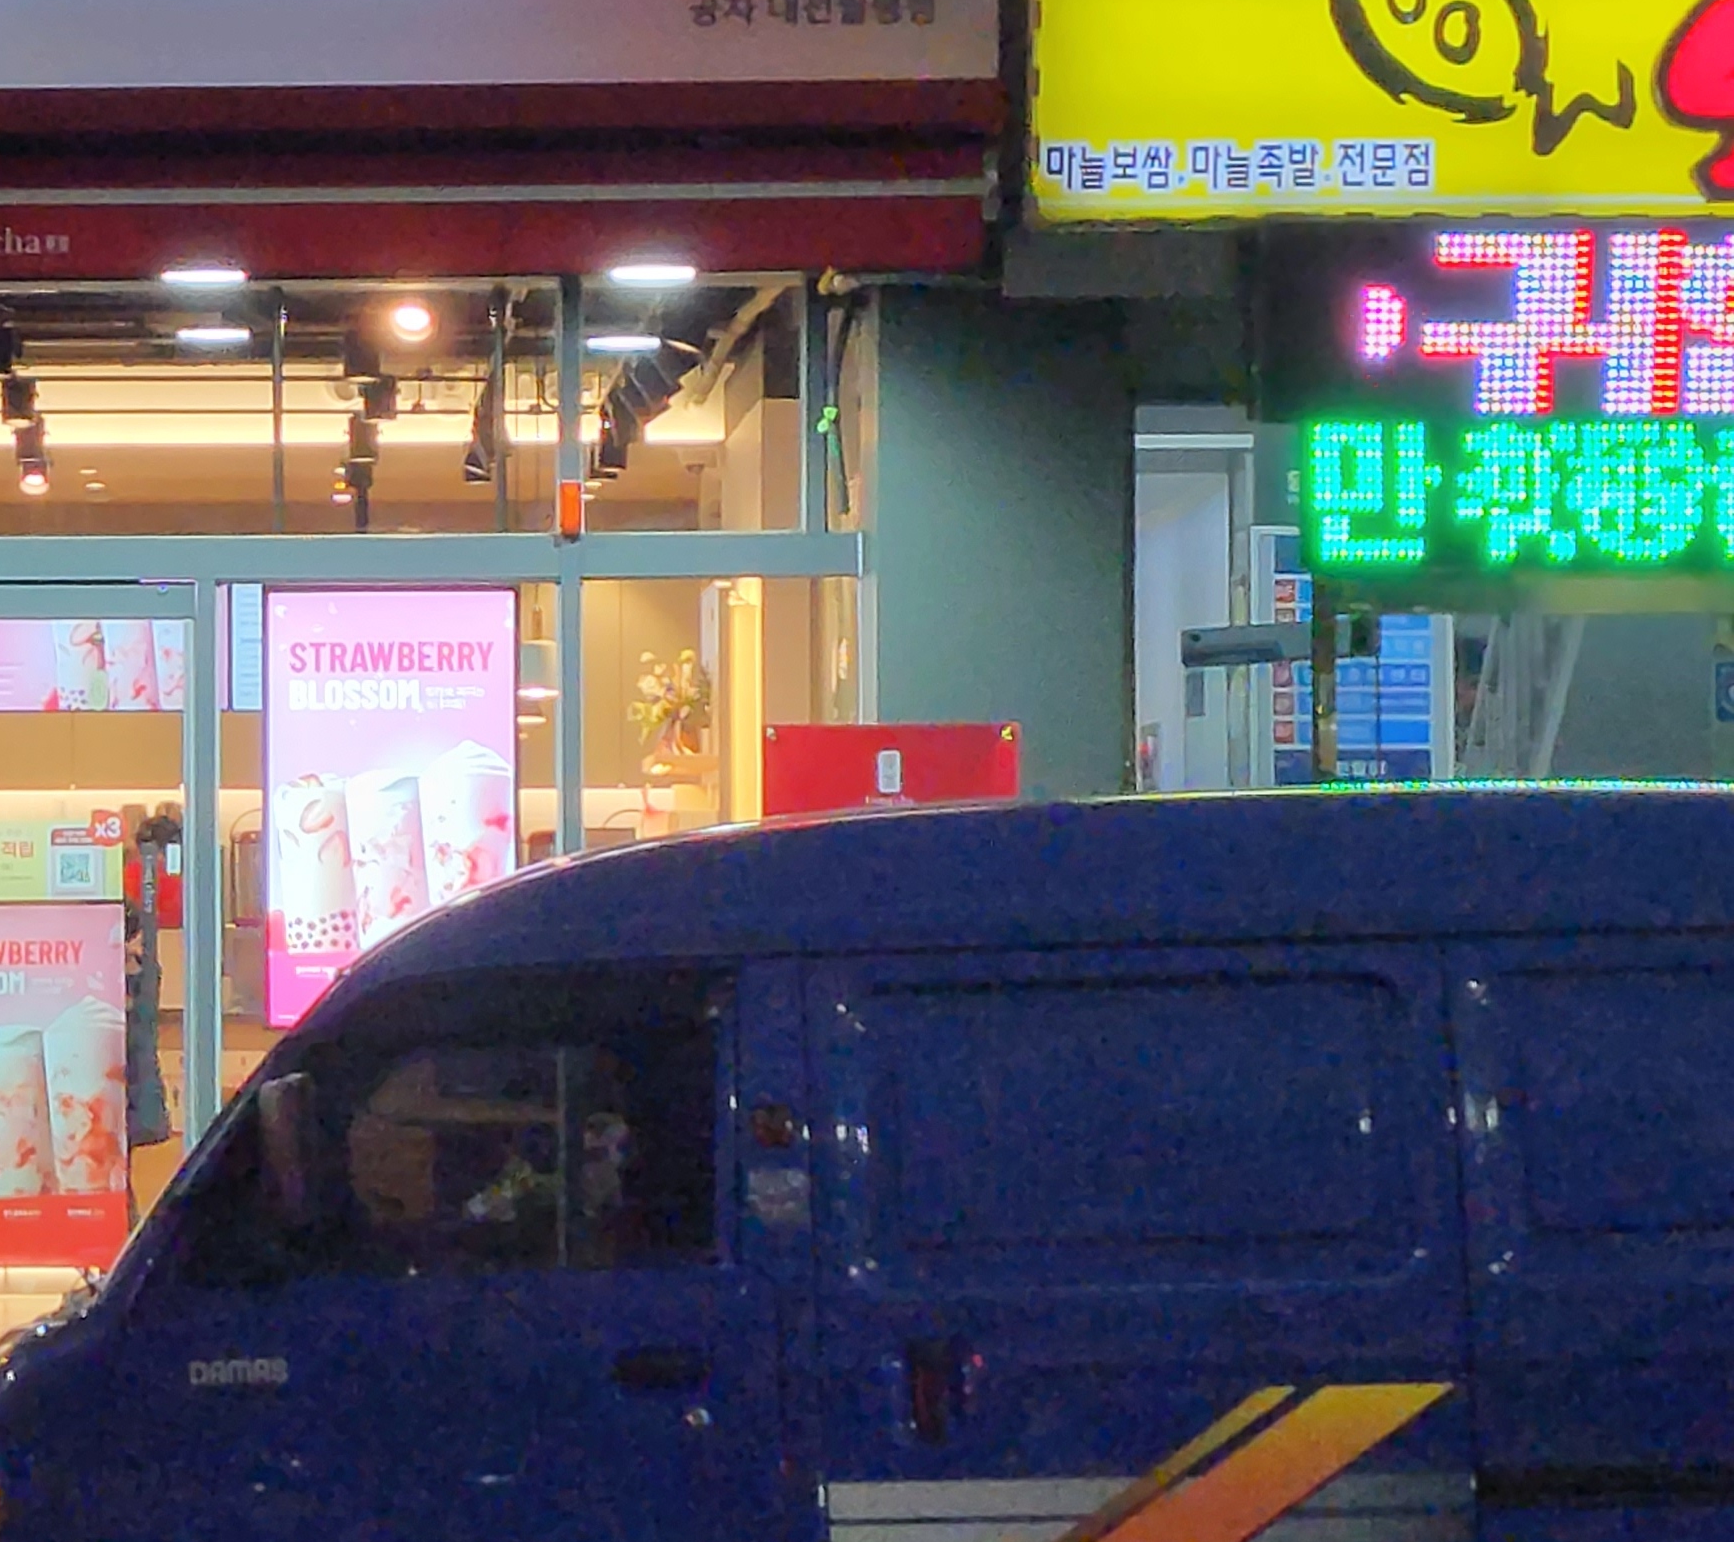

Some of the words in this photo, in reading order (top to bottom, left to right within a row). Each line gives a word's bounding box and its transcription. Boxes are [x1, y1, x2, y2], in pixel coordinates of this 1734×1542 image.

[1336, 141, 1432, 189] 전문점
[289, 641, 495, 673] STRAWBERRY
[288, 678, 421, 711] BLOSSOM
